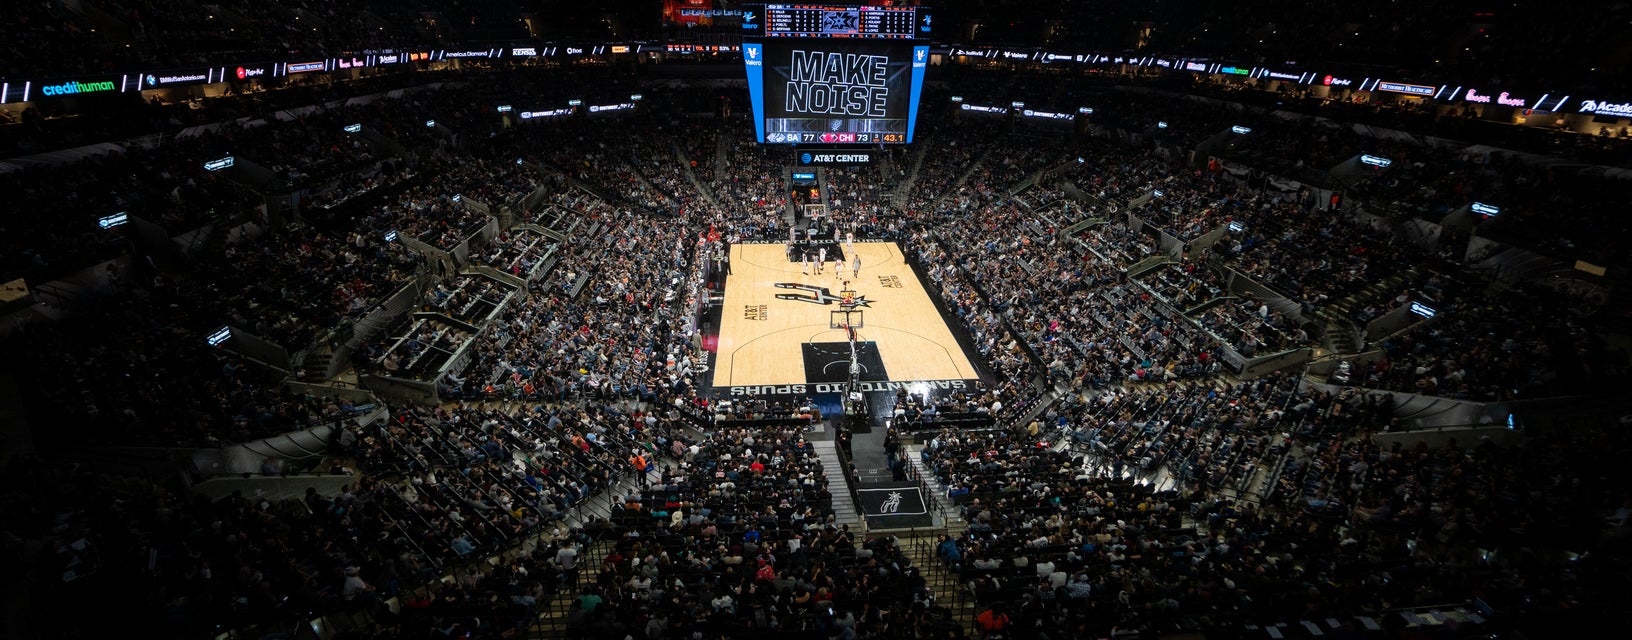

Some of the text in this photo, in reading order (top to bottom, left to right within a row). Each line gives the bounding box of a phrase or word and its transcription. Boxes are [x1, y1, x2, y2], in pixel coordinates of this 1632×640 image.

[791, 50, 888, 87] MAKE
[43, 81, 115, 96] credithuman
[786, 81, 888, 117] NOISE
[745, 305, 758, 320] AT&T
[730, 384, 806, 395] SPURS
